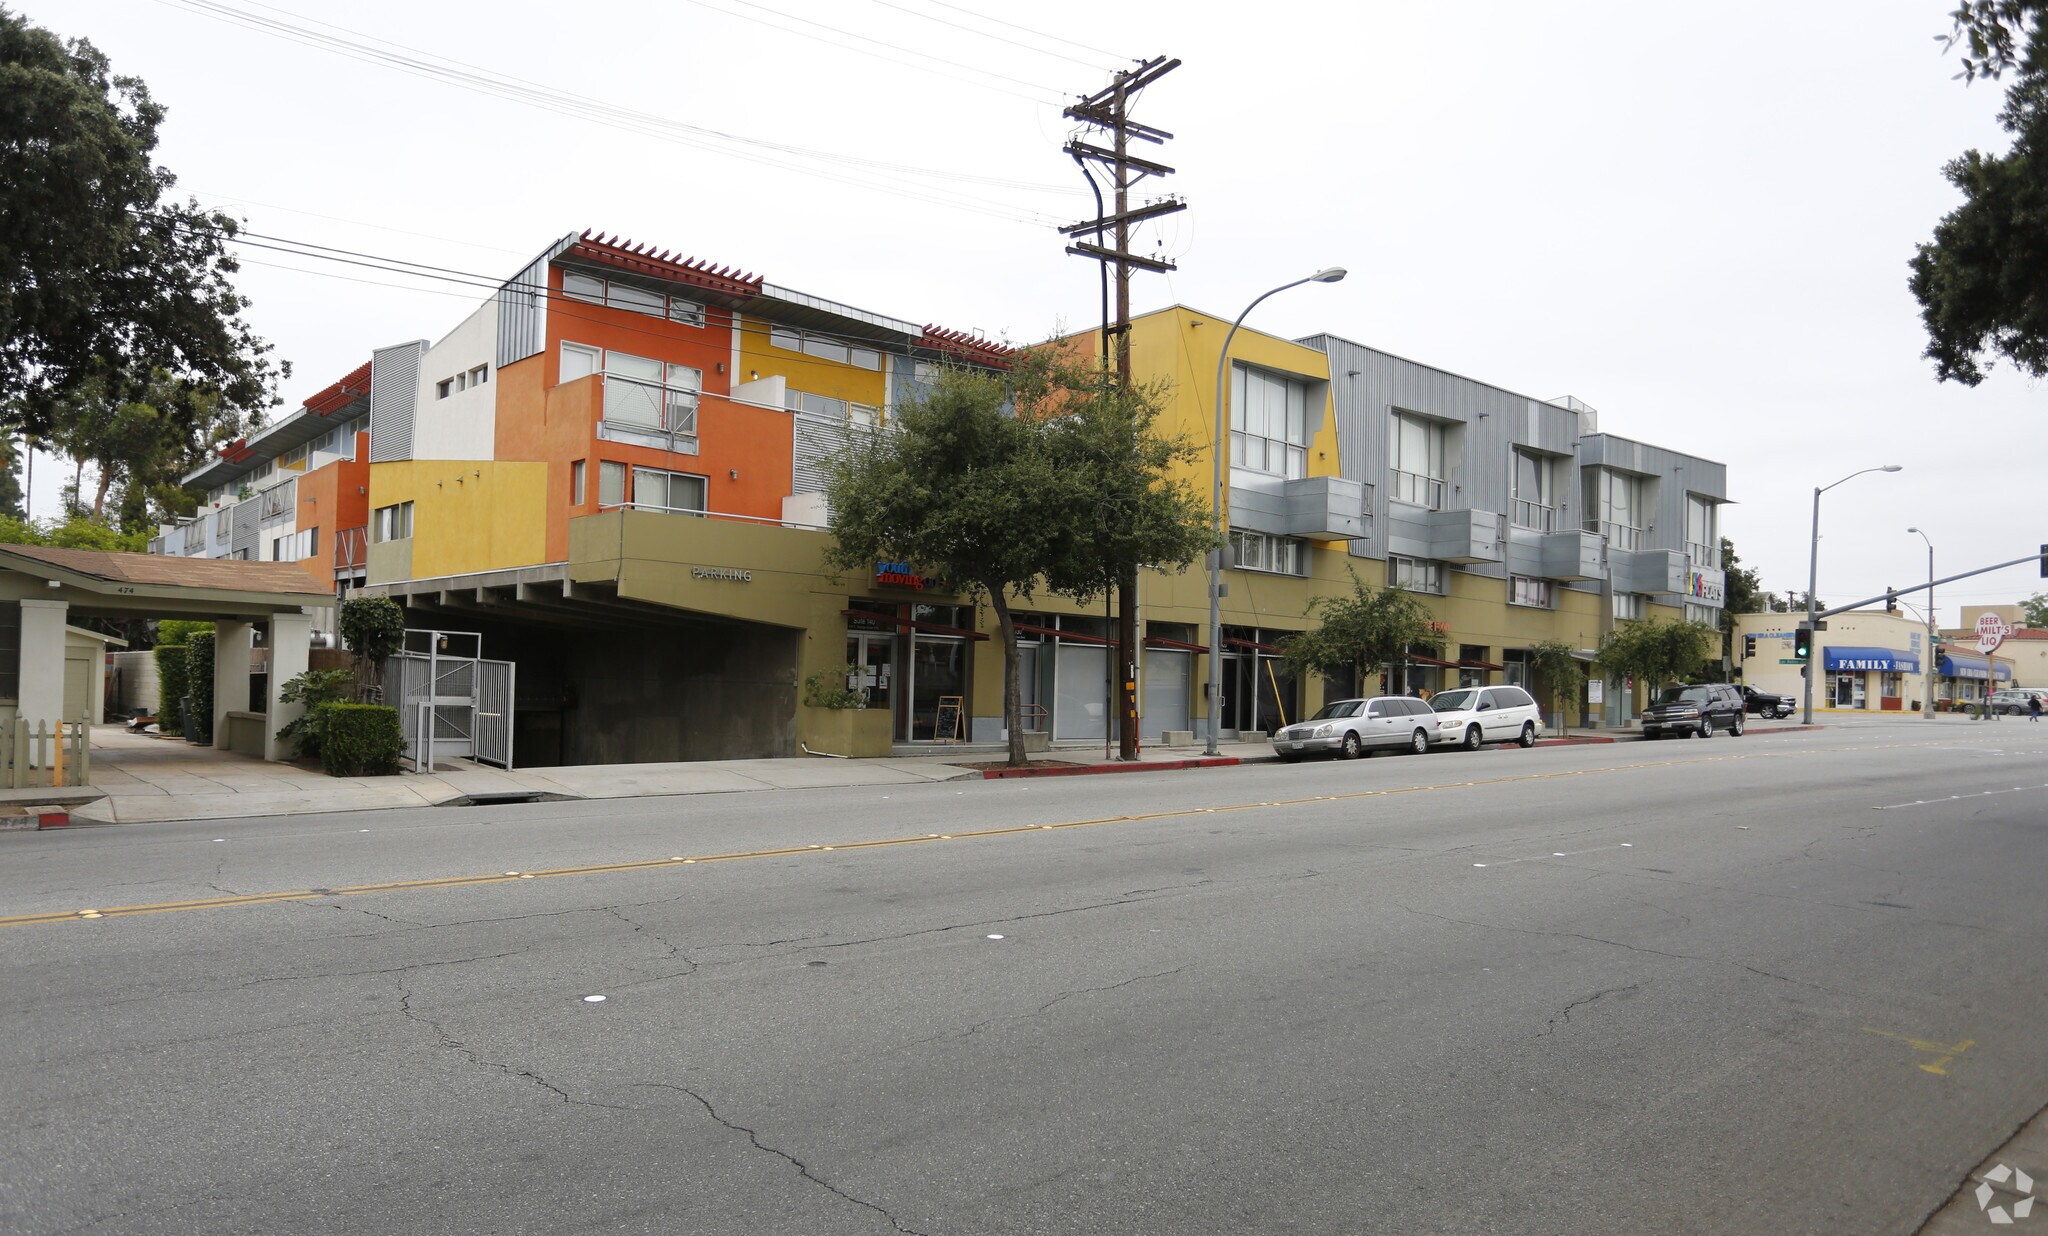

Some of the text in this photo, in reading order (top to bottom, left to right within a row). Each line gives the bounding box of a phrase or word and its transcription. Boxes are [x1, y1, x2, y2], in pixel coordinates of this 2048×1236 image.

[691, 566, 752, 582] PARKING
[877, 572, 924, 591] moving
[1703, 585, 1723, 600] FLATS
[1980, 617, 1998, 625] BEER
[1980, 626, 2010, 635] MILT'S
[1981, 637, 1997, 646] LIQ
[1838, 660, 1890, 670] FAMILY
